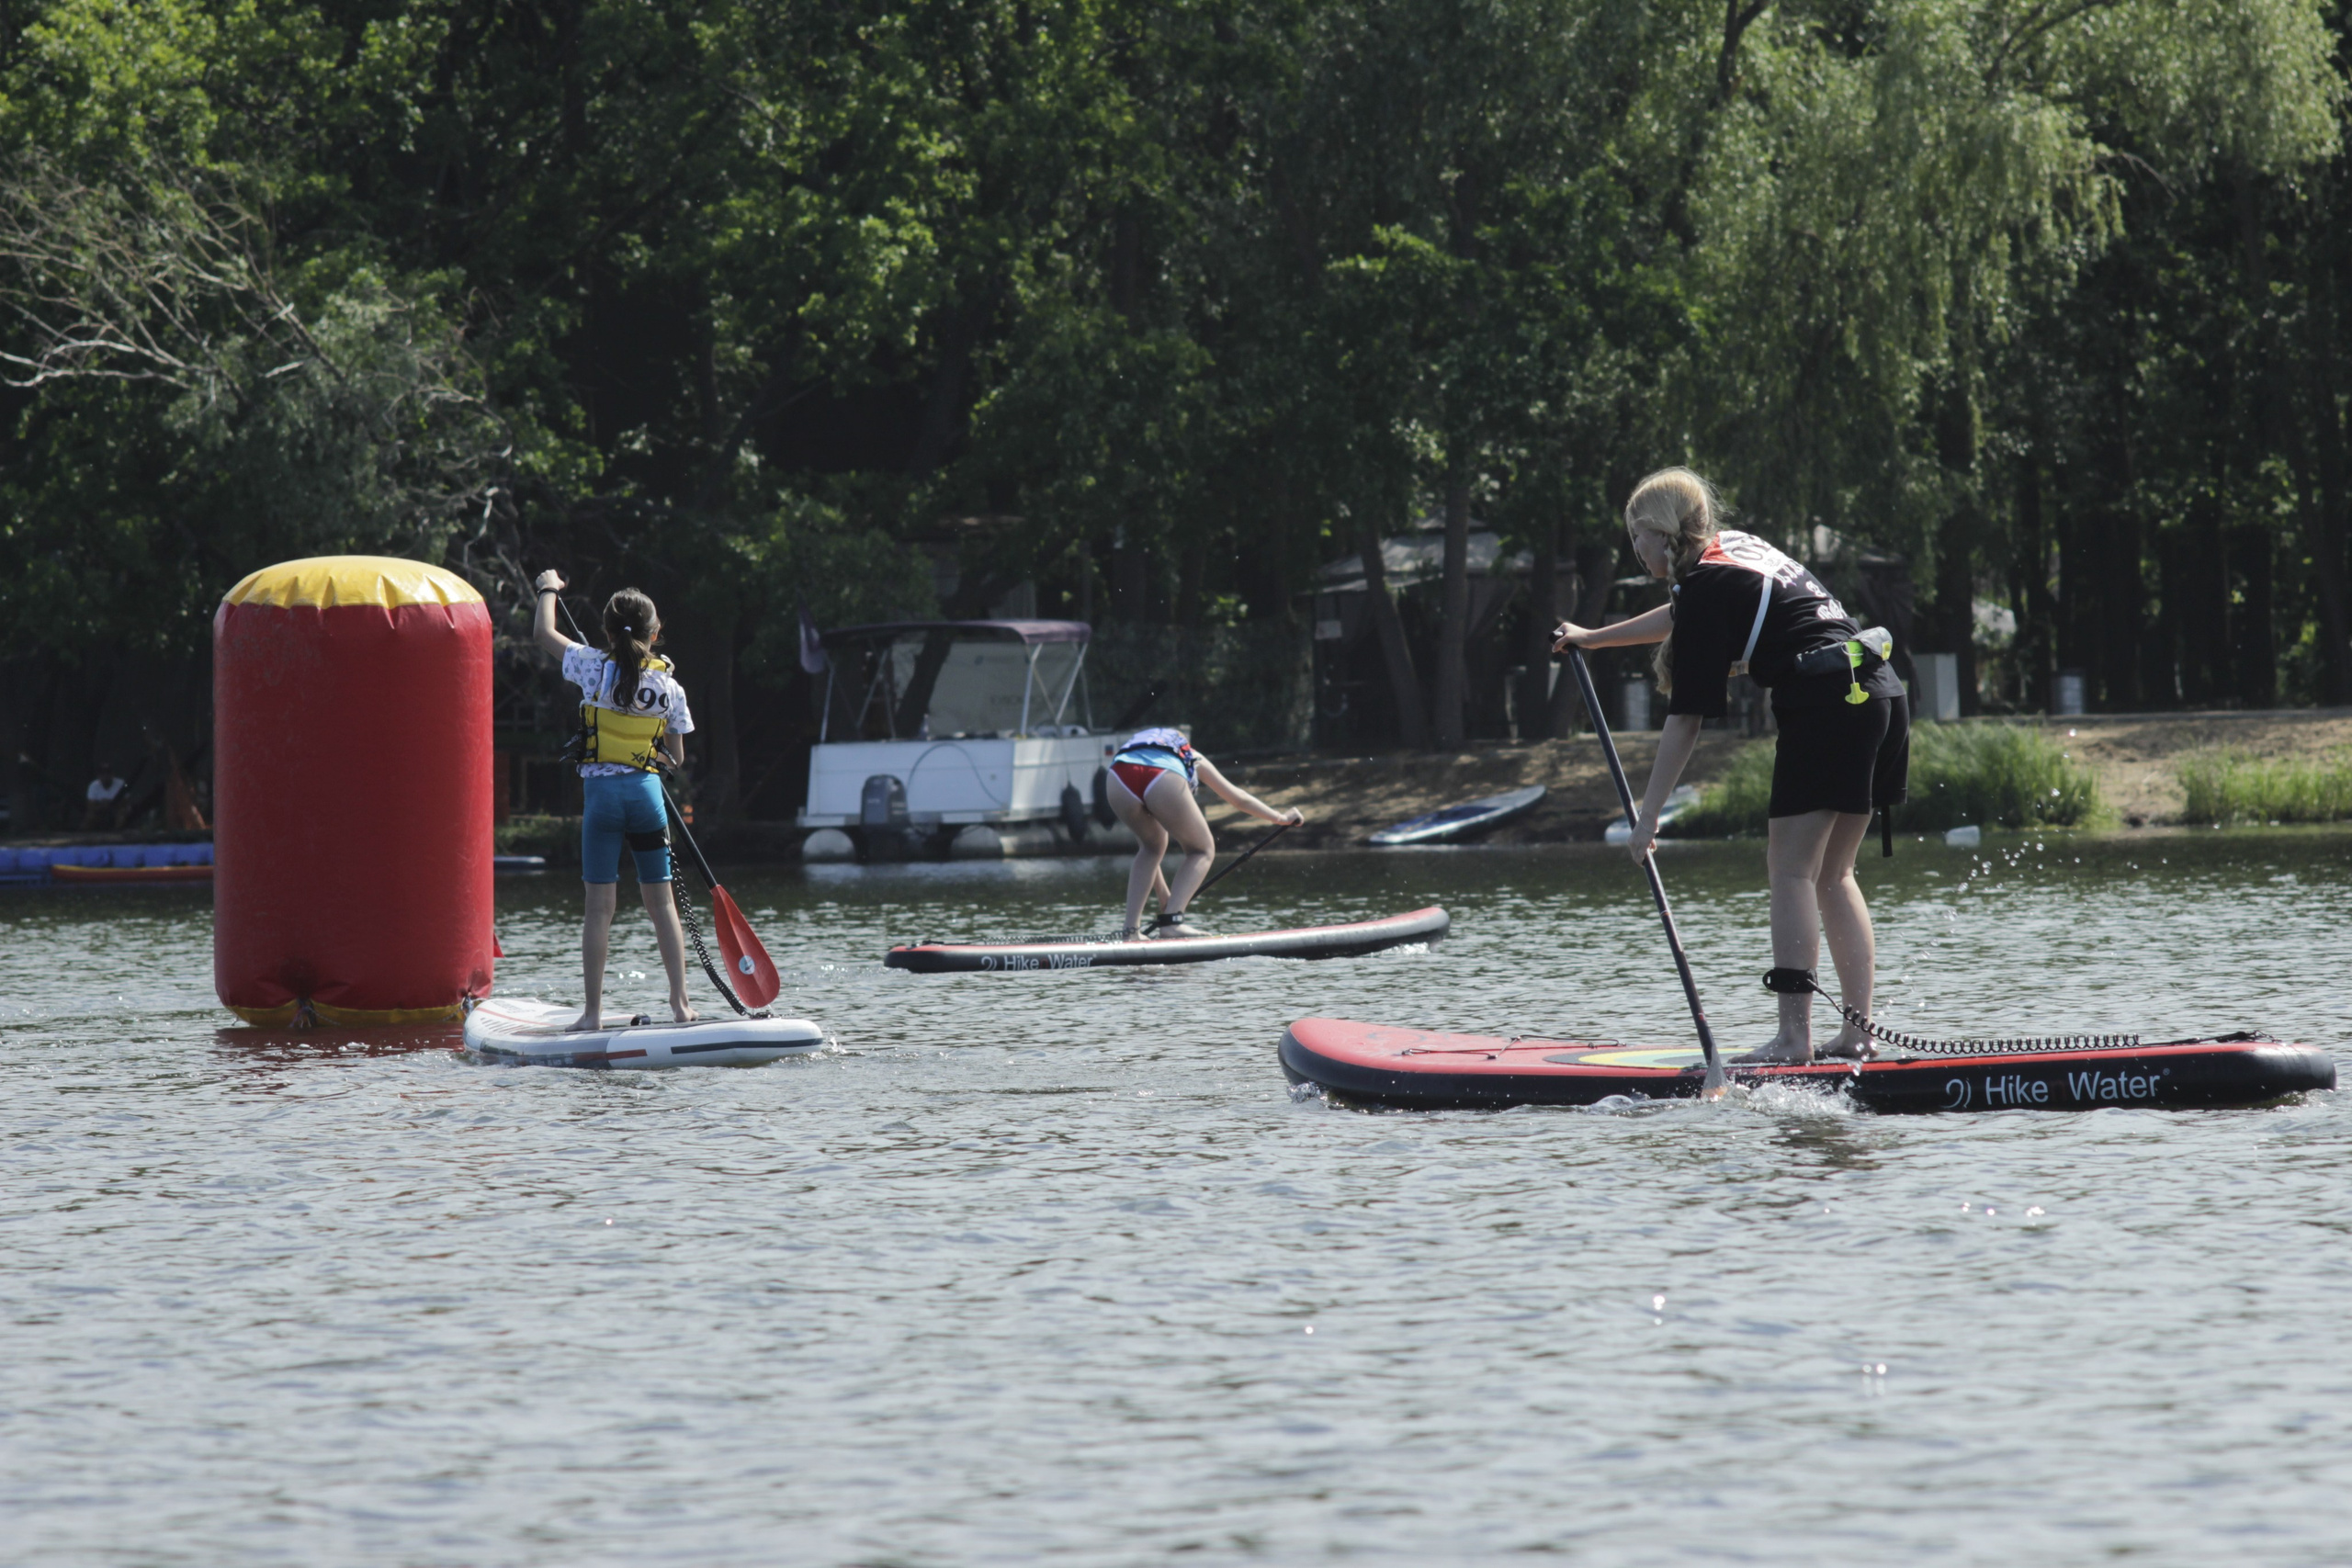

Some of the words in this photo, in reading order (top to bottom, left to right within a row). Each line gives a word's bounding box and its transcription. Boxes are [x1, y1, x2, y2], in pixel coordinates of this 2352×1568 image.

[1003, 955, 1039, 971] Hike
[1047, 953, 1092, 969] Water
[1985, 1074, 2049, 1105] Hike
[2067, 1070, 2161, 1101] Water
